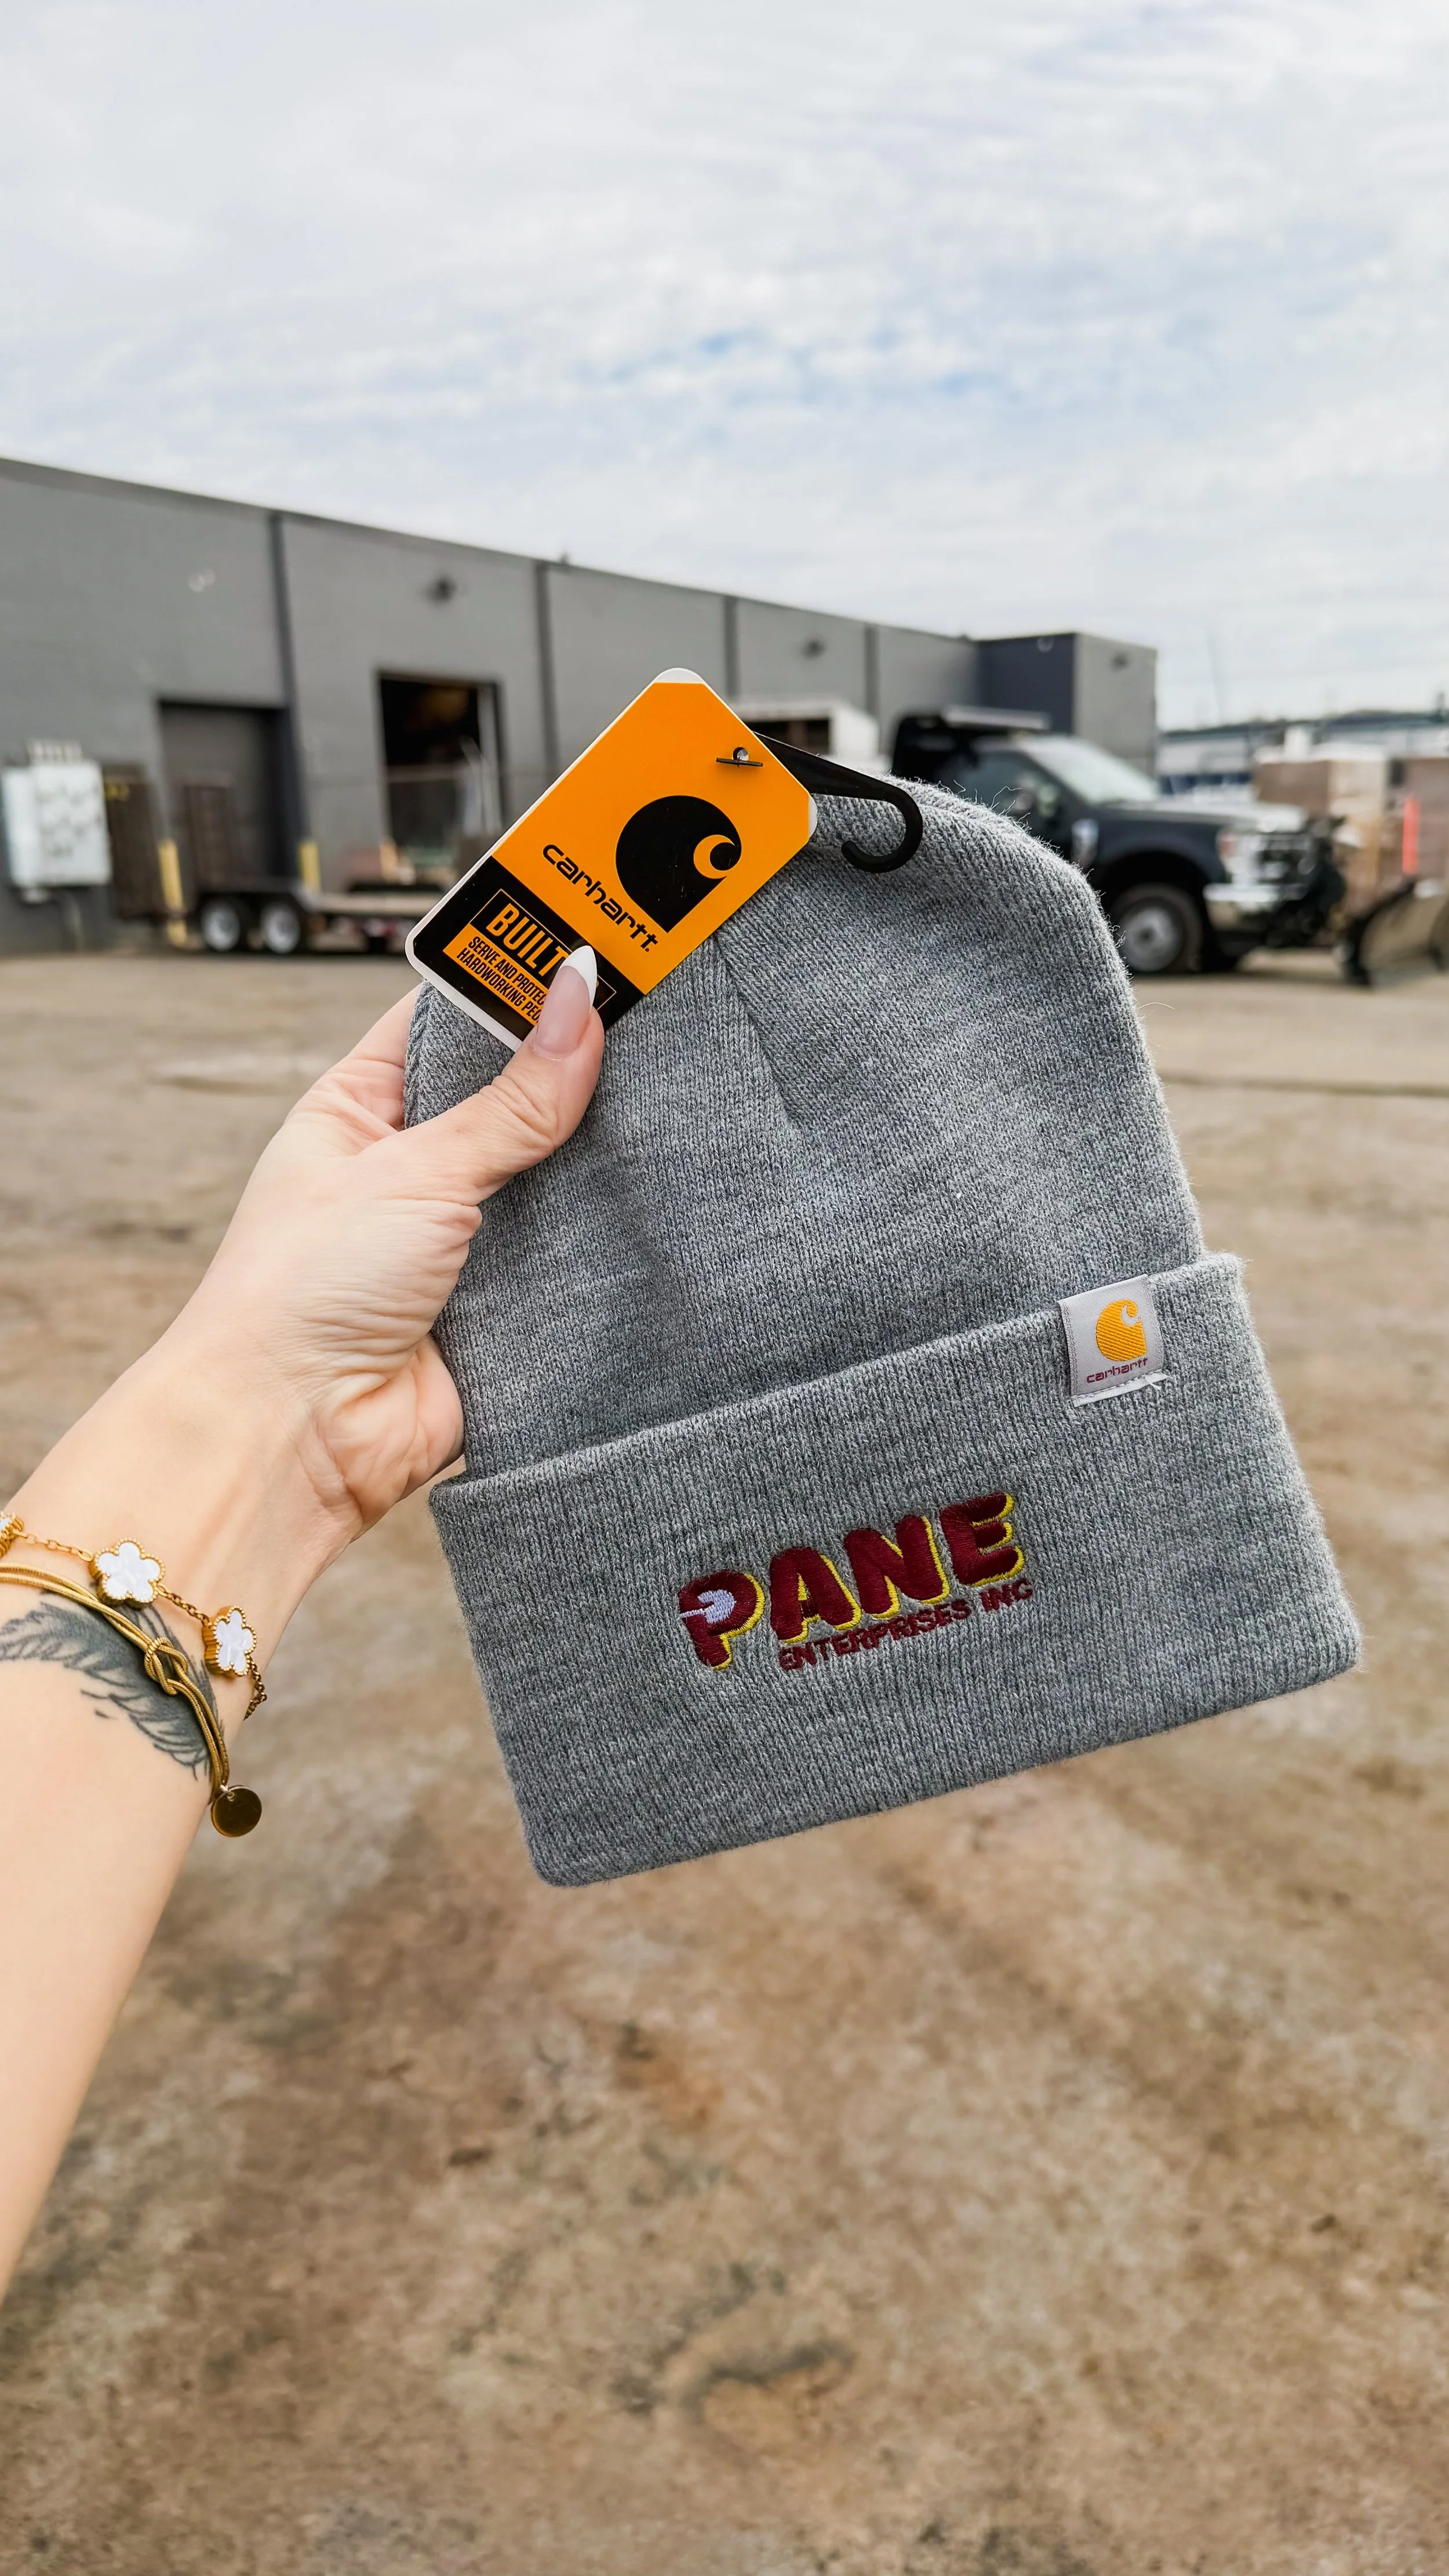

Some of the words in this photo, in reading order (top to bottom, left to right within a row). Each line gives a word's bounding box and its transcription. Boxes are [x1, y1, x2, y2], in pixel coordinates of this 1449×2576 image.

[468, 936, 501, 966] SERVE
[493, 958, 518, 980] AND
[512, 973, 547, 1006] PROTEC
[486, 903, 569, 977] BUILT
[456, 947, 526, 1007] HARDWORKING
[521, 1000, 542, 1023] PEO
[1087, 1357, 1148, 1383] carhartt
[678, 1493, 1025, 1671] PANE
[778, 1599, 971, 1671] ENTERPRISES
[979, 1577, 1033, 1611] INC
